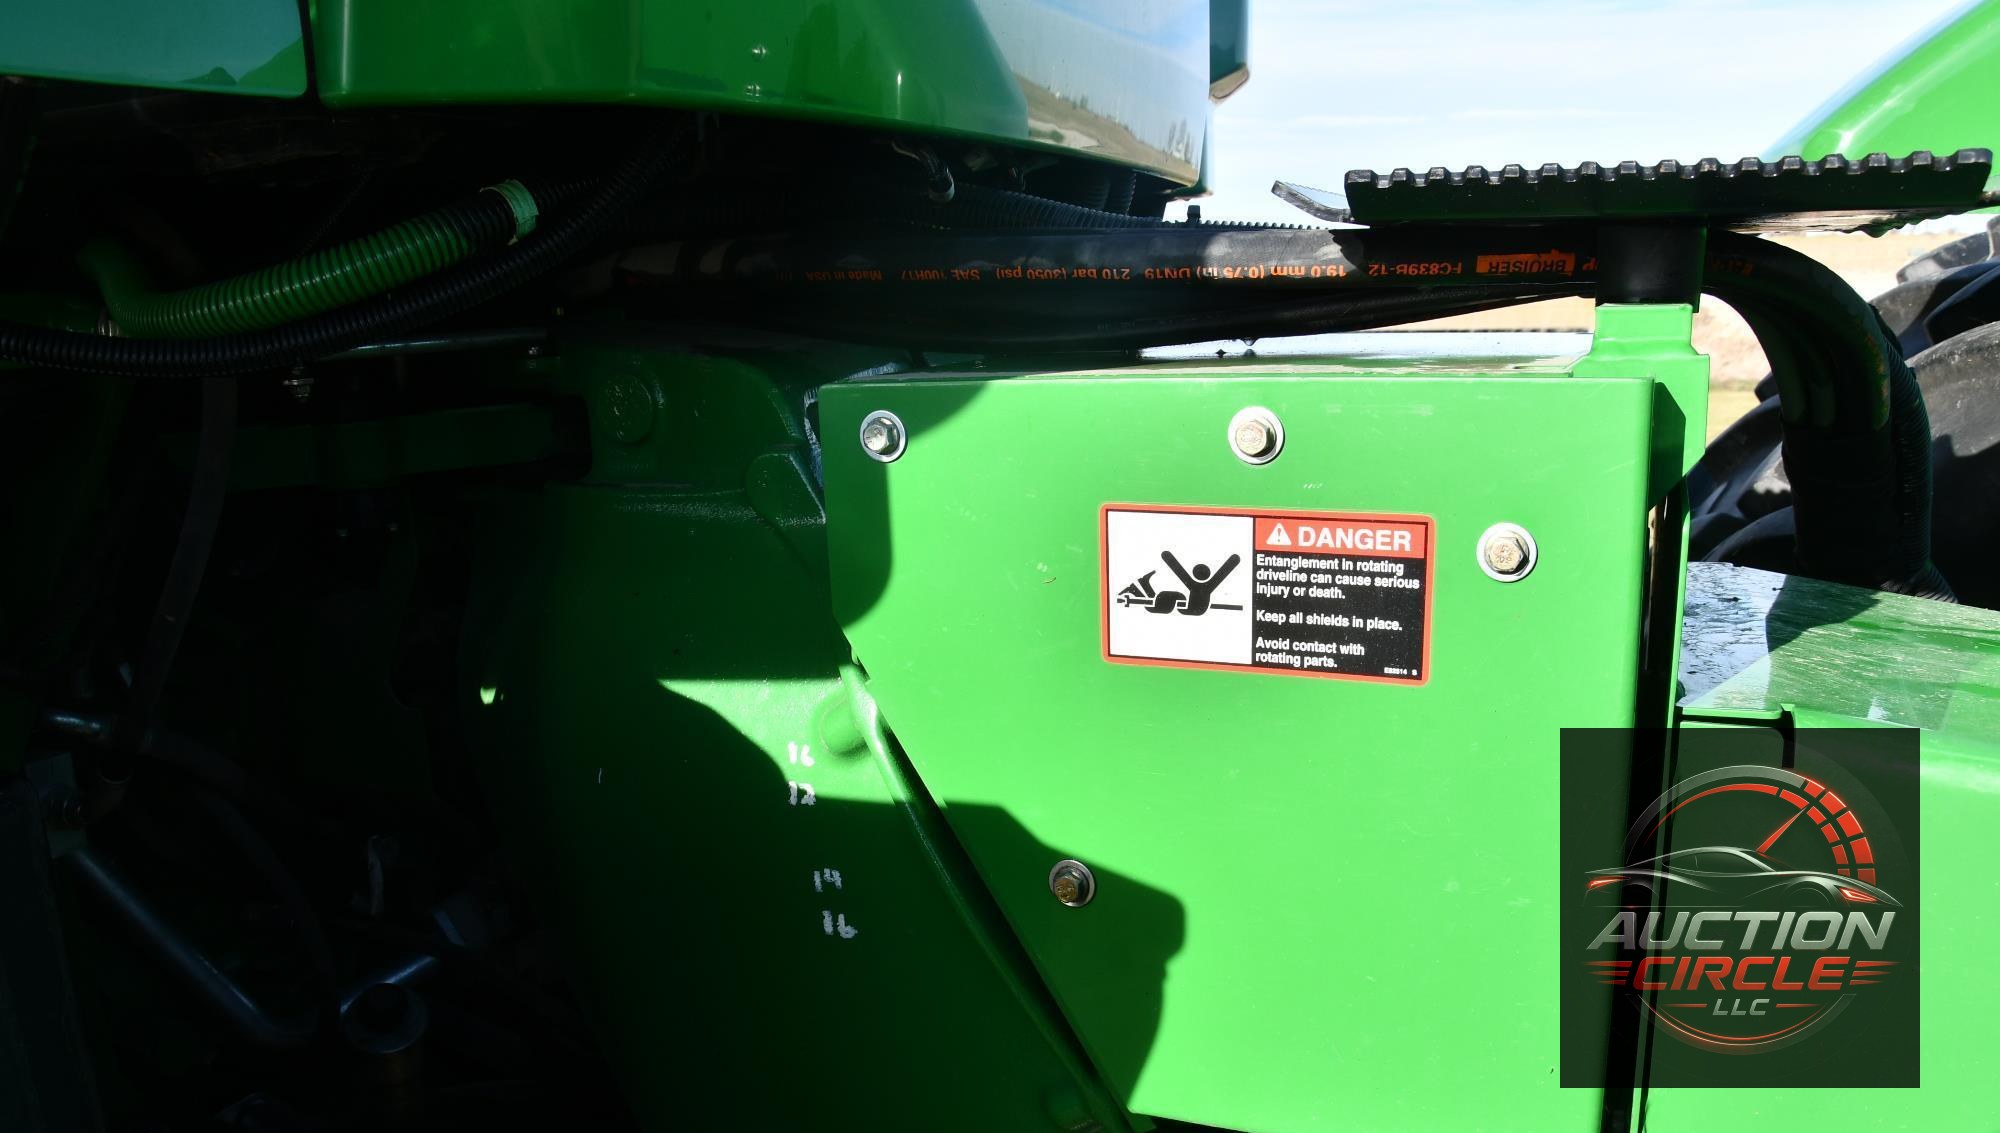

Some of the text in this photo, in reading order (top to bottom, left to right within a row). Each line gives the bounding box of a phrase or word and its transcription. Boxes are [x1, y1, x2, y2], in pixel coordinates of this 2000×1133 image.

[995, 266, 1022, 281] psi)
[1144, 267, 1191, 280] DN19
[1196, 265, 1219, 280] in)
[1223, 264, 1265, 279] (0.75
[1271, 266, 1306, 277] mm
[1310, 265, 1347, 279] 19.0
[1368, 262, 1462, 276] FC839B-12
[1488, 258, 1566, 274] BRUISER
[950, 268, 981, 281] SAE
[1026, 268, 1067, 281] (3050
[1071, 268, 1097, 280] bar
[1102, 268, 1131, 280] 210
[1298, 527, 1411, 551] DANGER
[1256, 553, 1404, 576] Entanglement in rotating
[1256, 569, 1420, 589] driveline can cause serious
[1256, 582, 1345, 599] injury or death.
[1256, 610, 1403, 631] Keep all shields in place.
[1256, 637, 1365, 657] Avoid contact with
[1256, 651, 1337, 669] rotating parts.
[788, 740, 815, 767] 16
[813, 867, 842, 893] 14
[822, 910, 858, 939] 16
